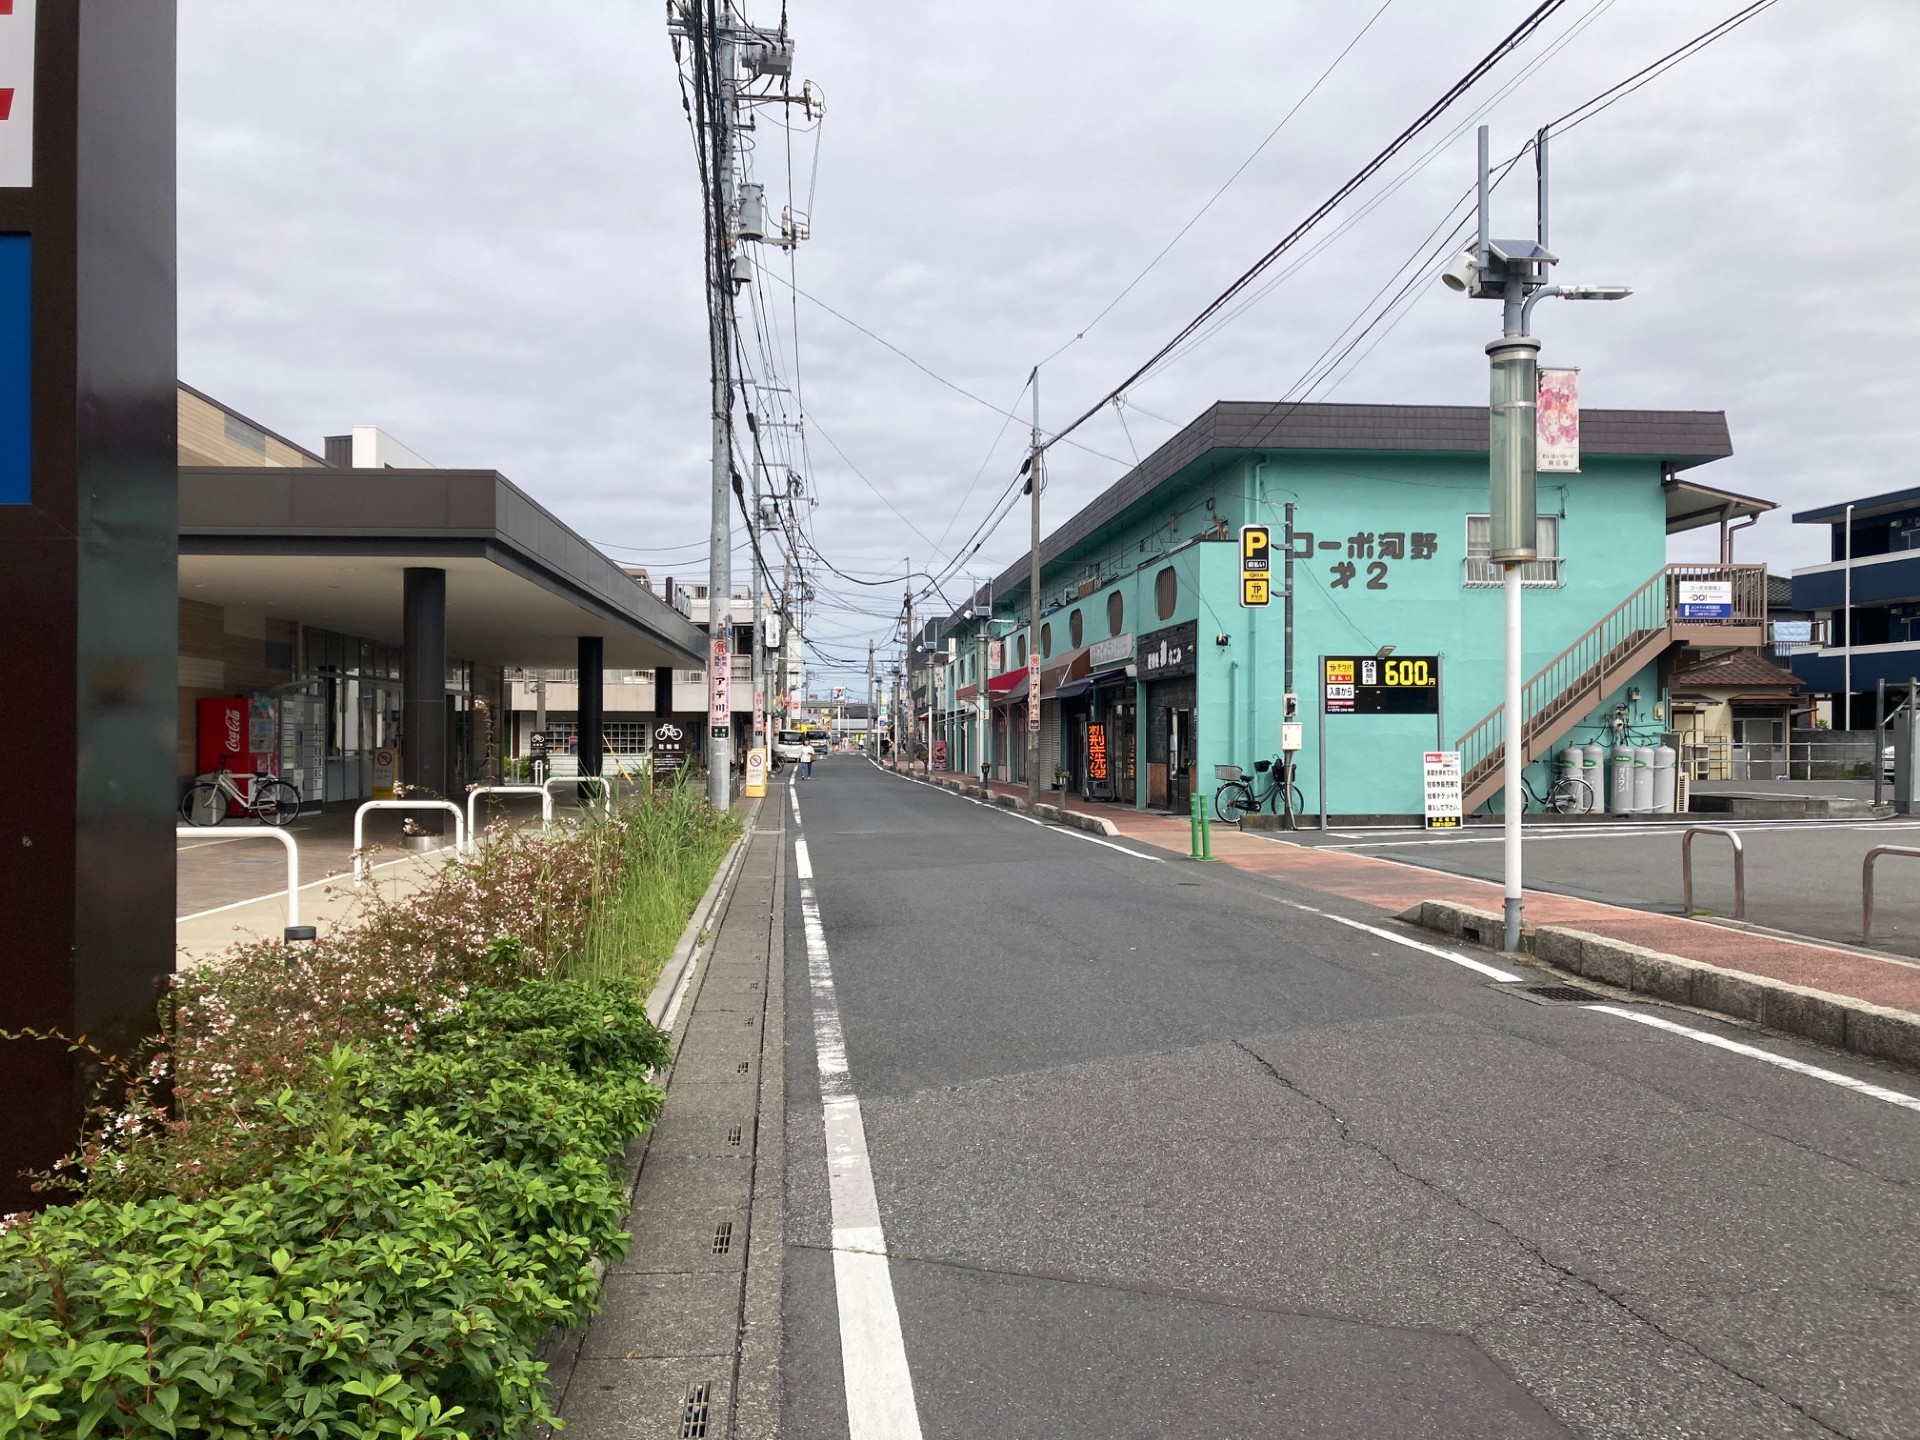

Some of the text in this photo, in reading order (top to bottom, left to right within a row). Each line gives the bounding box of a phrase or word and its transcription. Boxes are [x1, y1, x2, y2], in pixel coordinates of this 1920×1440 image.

[1246, 531, 1267, 558] P
[1292, 531, 1438, 560] コーポ河野
[1329, 687, 1353, 697] 入庫から
[225, 707, 240, 752] Coca-Cola
[1618, 767, 1626, 793] ガスワン
